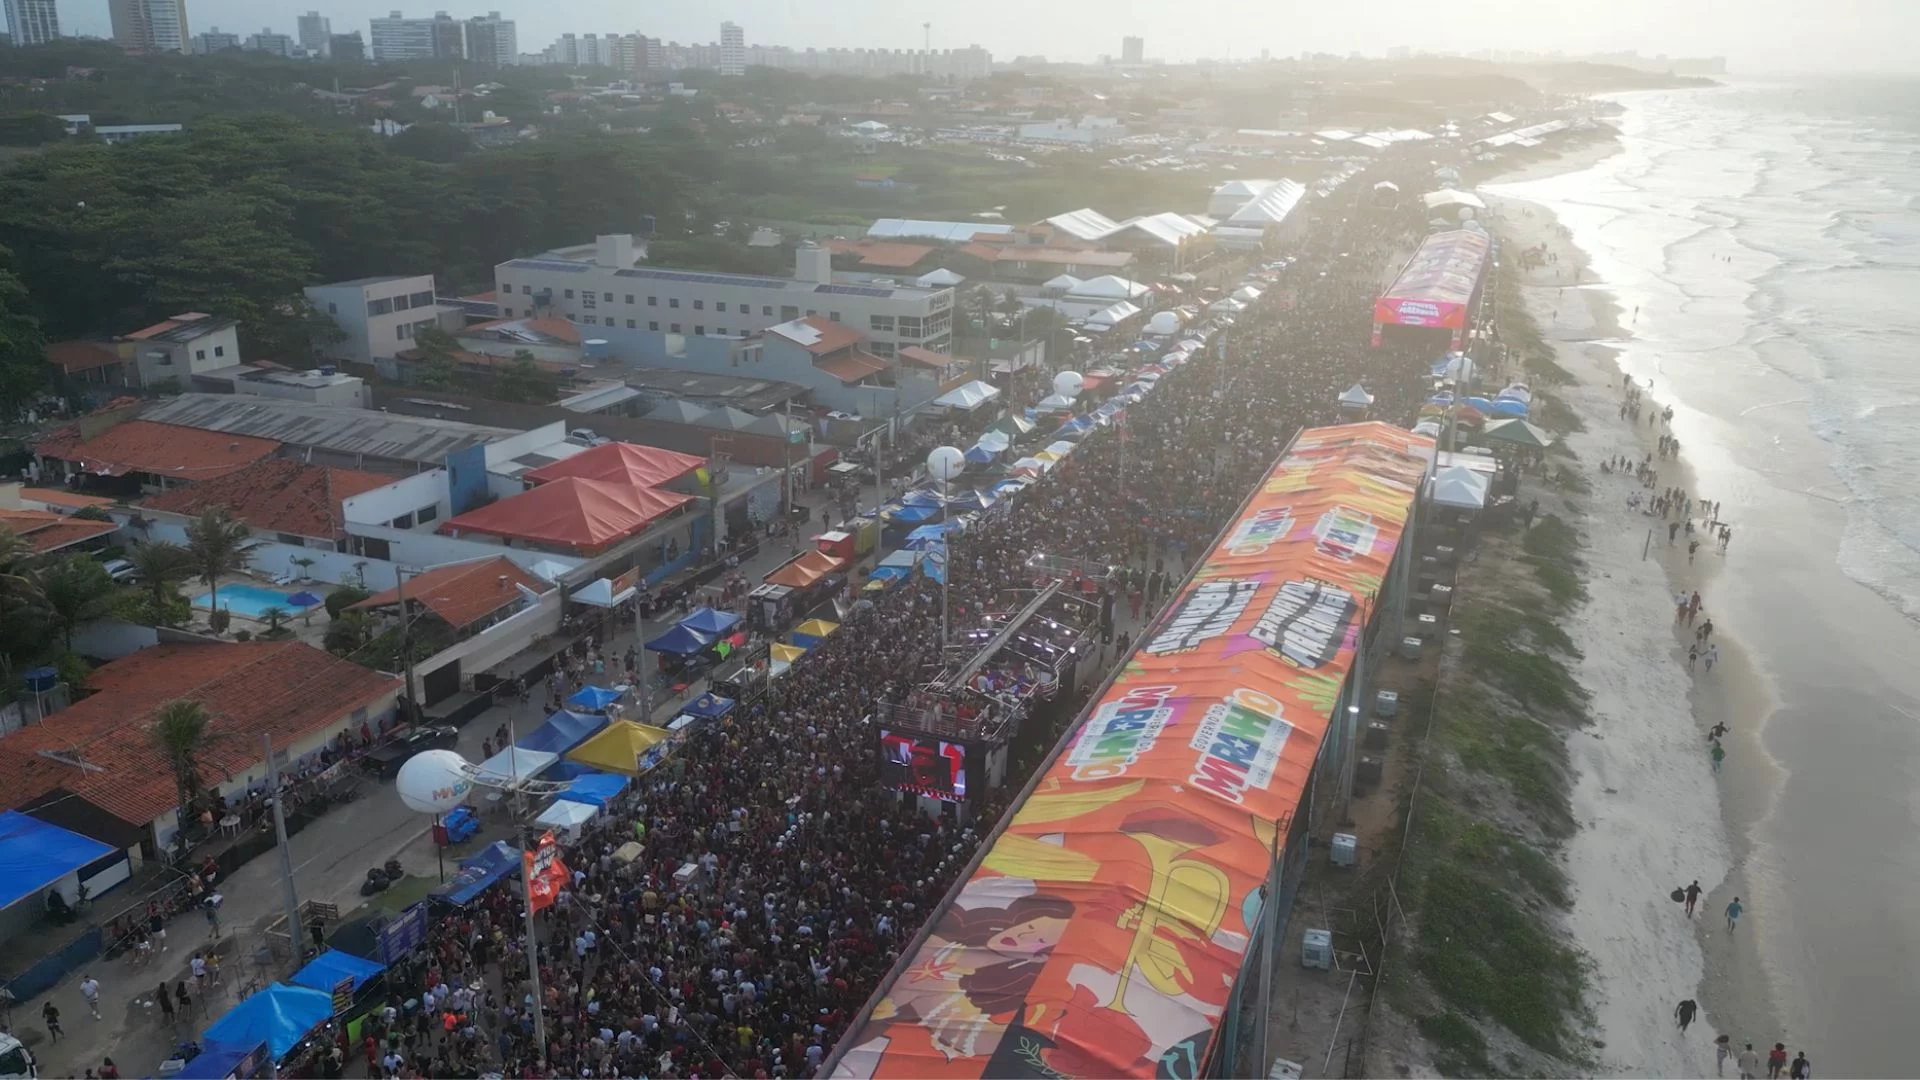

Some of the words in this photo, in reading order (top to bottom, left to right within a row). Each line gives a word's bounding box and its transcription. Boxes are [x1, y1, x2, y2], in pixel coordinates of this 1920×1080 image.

[1248, 580, 1317, 646] CARNAVAL
[1193, 688, 1281, 801] MARANHO
[1194, 716, 1220, 750] GOVERNO
